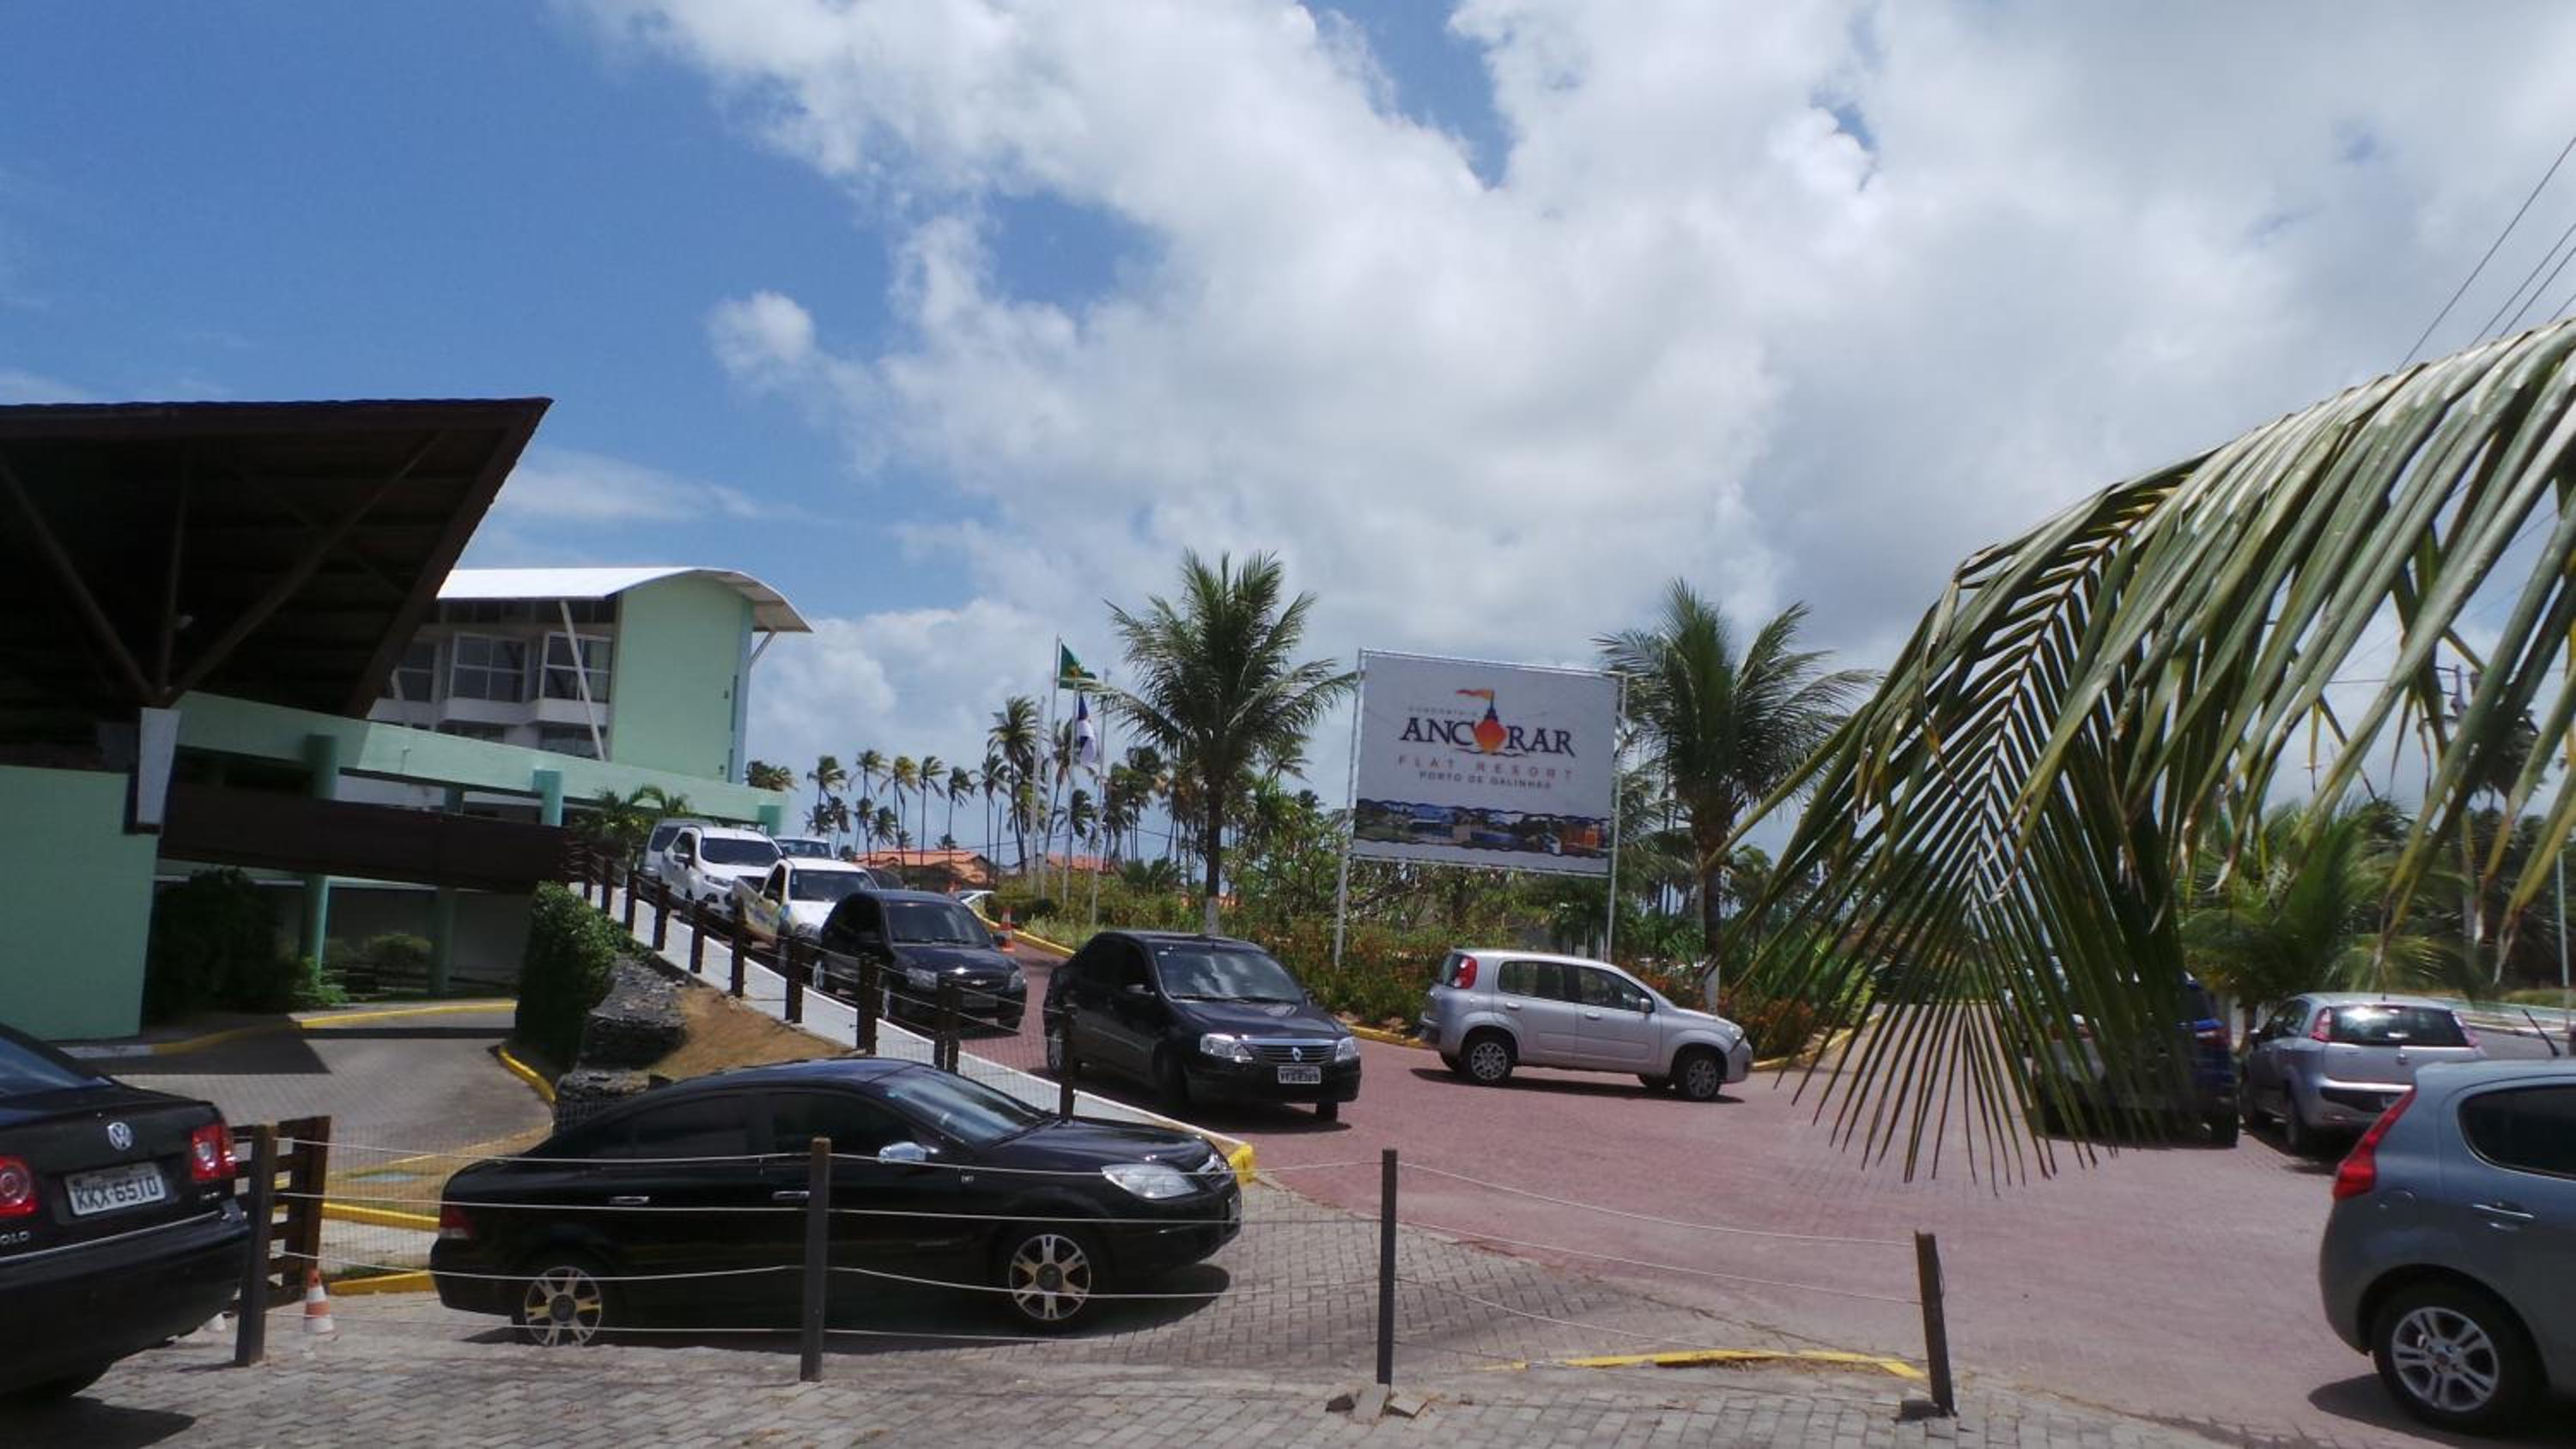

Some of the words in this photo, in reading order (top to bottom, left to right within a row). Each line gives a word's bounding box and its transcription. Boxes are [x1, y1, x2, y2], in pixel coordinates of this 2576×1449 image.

[1398, 717, 1575, 757] ANCORAR
[1398, 755, 1455, 769] FLAT
[1476, 761, 1573, 780] RESORT
[1419, 770, 1463, 783] PORTO
[1467, 774, 1484, 784] DE
